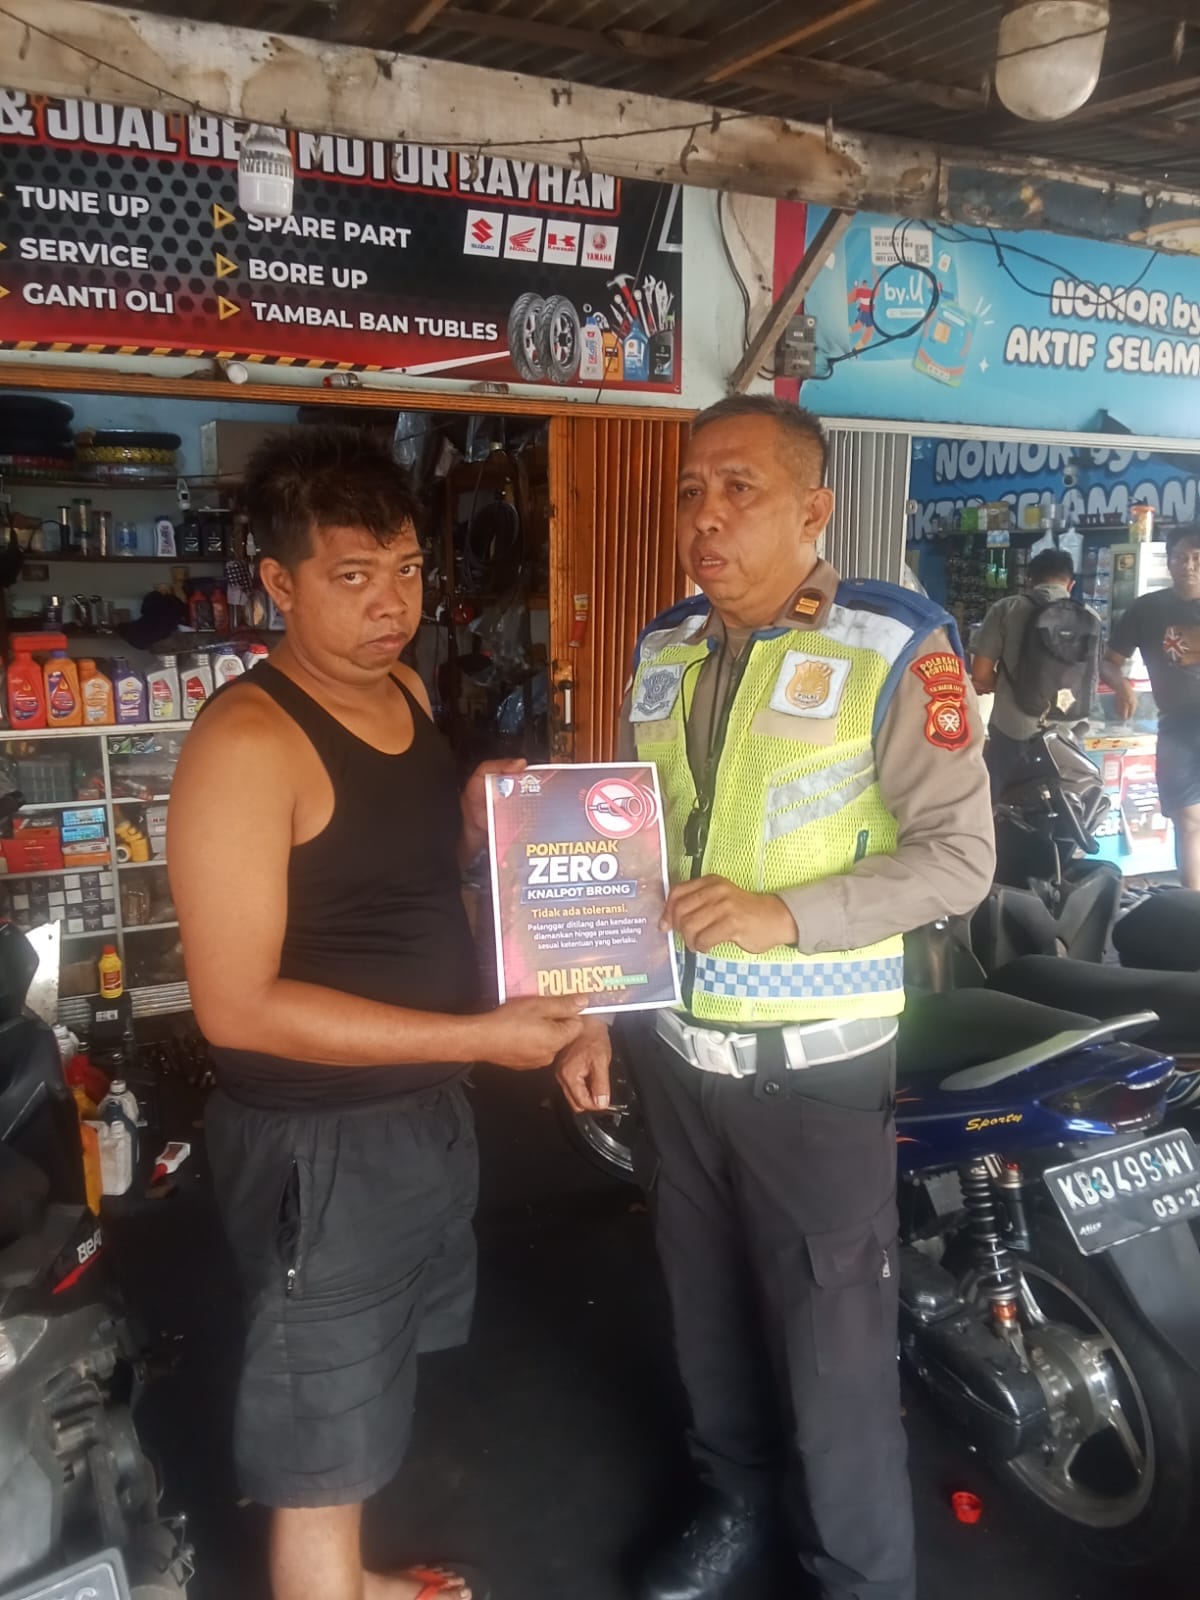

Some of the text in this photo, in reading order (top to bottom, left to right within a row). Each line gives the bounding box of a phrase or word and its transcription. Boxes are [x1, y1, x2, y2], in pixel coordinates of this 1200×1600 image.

[47, 99, 178, 153] JUAL
[188, 114, 288, 164] BE
[459, 152, 615, 210] RAYHAN
[15, 184, 150, 218] TUNE UP
[247, 213, 412, 249] SPARE PART
[19, 237, 149, 269] SERVICE
[586, 252, 612, 263] YAMAHA
[249, 259, 368, 289] BORE UP
[22, 282, 175, 314] GANTI OLI
[1051, 279, 1169, 326] NOMOR
[251, 301, 498, 341] TAMBAL BAN TUBLES
[1005, 327, 1096, 368] AKTIF
[526, 839, 619, 857] PONTIANAK
[528, 854, 618, 885] ZERO
[527, 885, 631, 900] KNALPOT BRONG
[527, 922, 565, 932] Pelanggar
[595, 918, 609, 927] dan
[609, 916, 647, 926] kendaraan
[531, 903, 629, 919] Tidak ada toleransi.
[534, 931, 574, 941] diamankan
[574, 929, 597, 940] hingga
[598, 928, 619, 938] proses
[537, 941, 560, 950] sesuai
[594, 938, 611, 948] yang
[537, 964, 626, 997] POLRESTA
[965, 1113, 1023, 1131] Sporty
